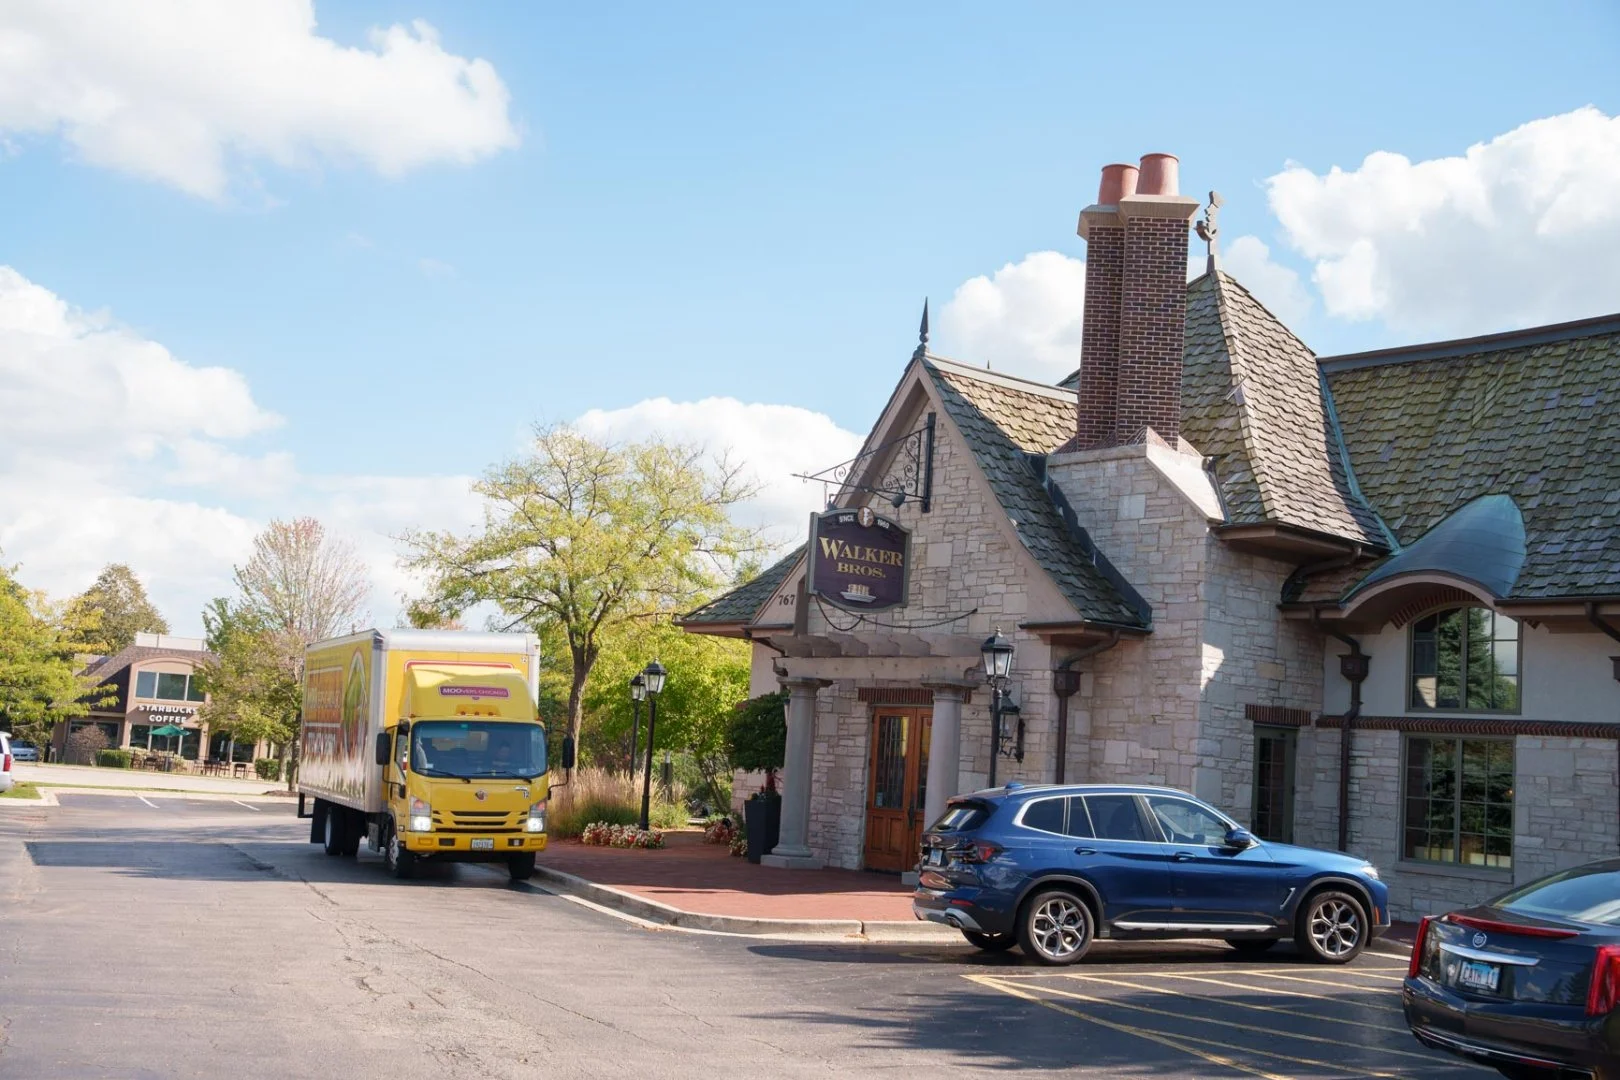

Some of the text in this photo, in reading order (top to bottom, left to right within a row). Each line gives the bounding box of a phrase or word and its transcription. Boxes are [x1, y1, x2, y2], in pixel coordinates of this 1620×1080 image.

[819, 536, 903, 567] WALKER
[837, 563, 887, 578] BROS.
[778, 594, 796, 606] 767
[149, 714, 187, 723] COFFEE
